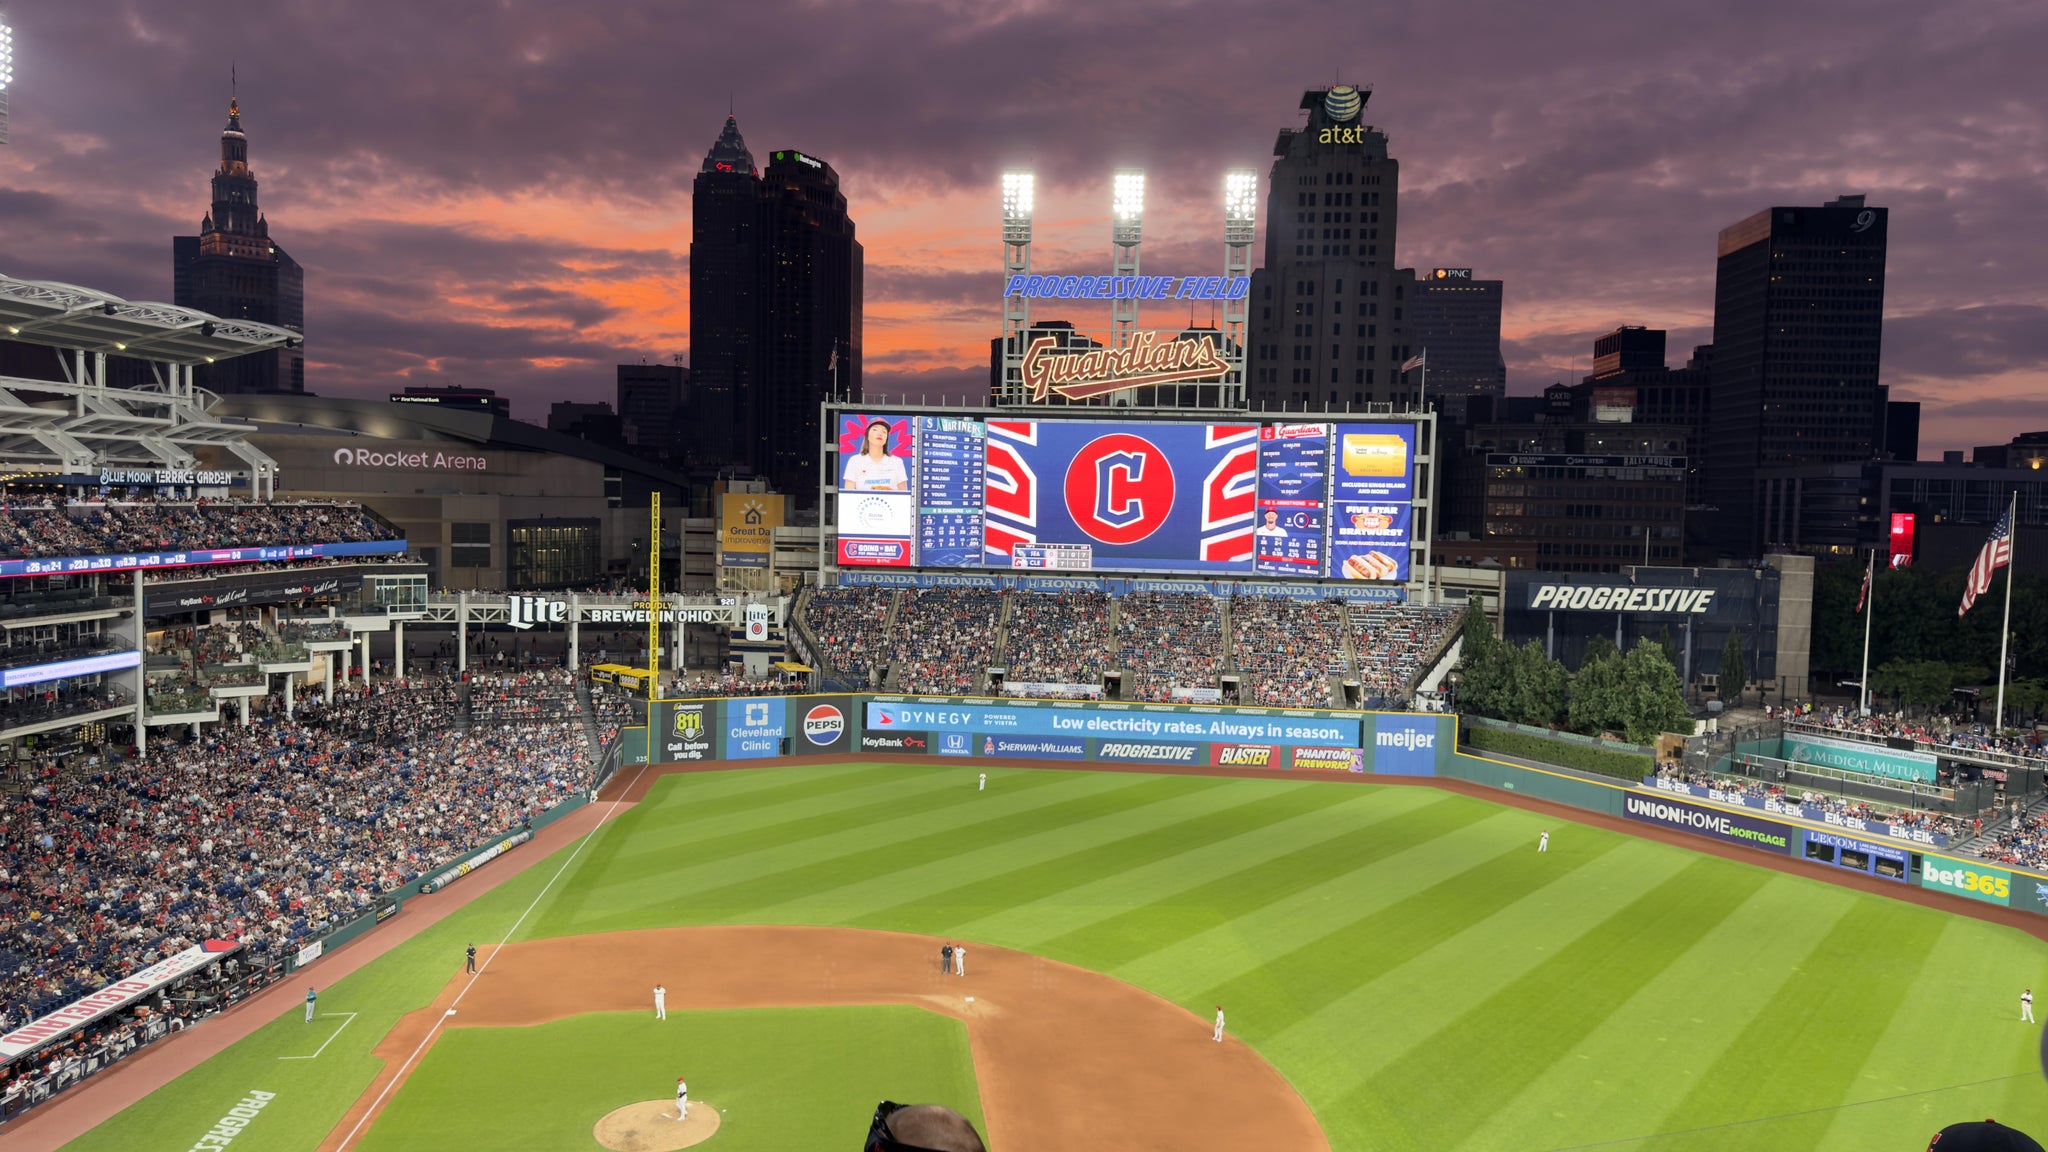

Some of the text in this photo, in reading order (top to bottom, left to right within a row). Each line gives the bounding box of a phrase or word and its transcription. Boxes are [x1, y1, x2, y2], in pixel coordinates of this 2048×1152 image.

[1319, 125, 1364, 144] at&t
[1448, 270, 1469, 278] PNC
[1003, 274, 1251, 300] PROGRESSIVE FIELD
[1021, 331, 1231, 403] Guardians
[927, 418, 933, 428] S
[1279, 424, 1322, 439] Guardians
[356, 449, 487, 470] Rocket Arena
[1624, 456, 1673, 468] RALLY HOUSE
[100, 468, 231, 484] BLUE MOON TERRACE GARDEN
[1094, 447, 1146, 530] C
[1345, 506, 1370, 514] FIVE
[730, 526, 771, 536] Great Da
[1339, 528, 1403, 537] BRATWURST
[31, 562, 40, 572] 26
[51, 561, 61, 571] 2-1
[74, 560, 89, 570] 23.0
[175, 554, 186, 564] 1.22
[861, 575, 918, 584] HONDA
[937, 578, 995, 587] HONDA
[1041, 580, 1099, 589] HONDA
[284, 587, 302, 595] KeyBank
[1149, 582, 1208, 592] HONDA
[1255, 585, 1317, 596] HONDA
[1336, 587, 1399, 598] HONDA
[1531, 585, 1715, 613] PROGRESSIVE
[507, 595, 568, 630] Lite
[591, 610, 713, 622] BREWED IN OHIO
[750, 611, 767, 622] Lite
[677, 713, 700, 730] 811
[901, 711, 972, 724] DYNEGY
[807, 719, 842, 730] PEPSI
[1052, 716, 1344, 740] Low electricity rates. Always in season.
[731, 727, 782, 738] Cleveland
[742, 741, 771, 751] Clinic
[862, 737, 903, 748] KeyBank
[1376, 729, 1435, 751] meijer
[674, 750, 703, 760] you dig.
[1100, 743, 1197, 761] PROGRESSIVE
[1219, 747, 1272, 766] BLASTER
[1295, 748, 1351, 760] PHANTOM
[1874, 747, 1903, 757] Cleveland
[1904, 751, 1935, 762] Guardians
[1294, 759, 1350, 770] FIREWORKS
[1729, 827, 1786, 847] MORTGAGE
[1923, 861, 2009, 898] bet365
[3, 981, 149, 1045] CLEVELAND
